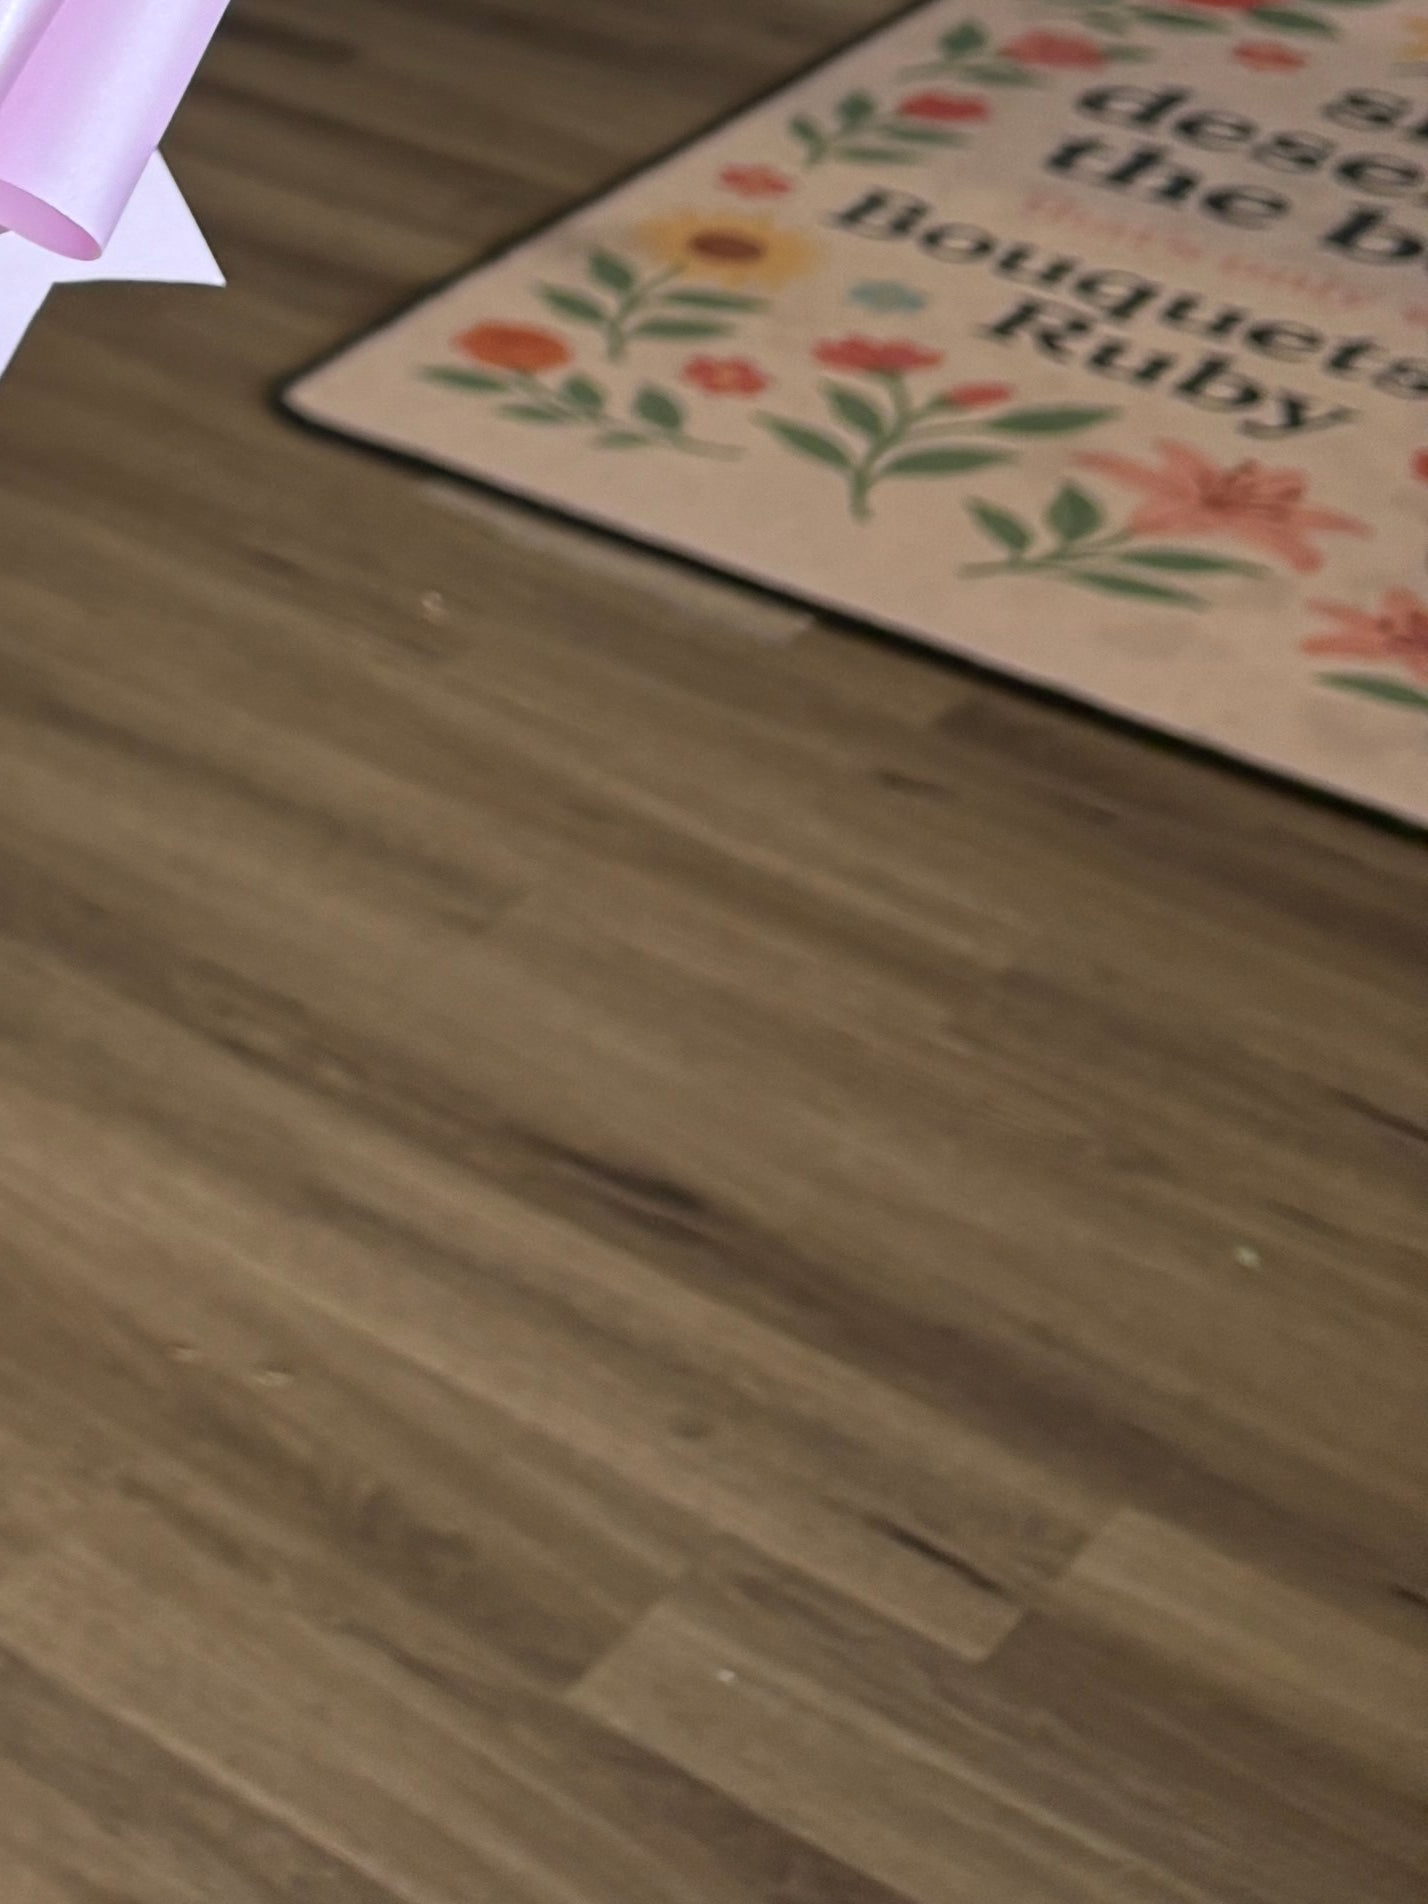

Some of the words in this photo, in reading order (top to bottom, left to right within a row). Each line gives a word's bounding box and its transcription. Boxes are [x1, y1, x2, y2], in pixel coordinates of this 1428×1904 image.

[1075, 84, 1428, 208] dese
[1320, 87, 1428, 142] s
[1045, 134, 1290, 230] the
[1320, 202, 1428, 274] b
[976, 297, 1358, 440] Ruby
